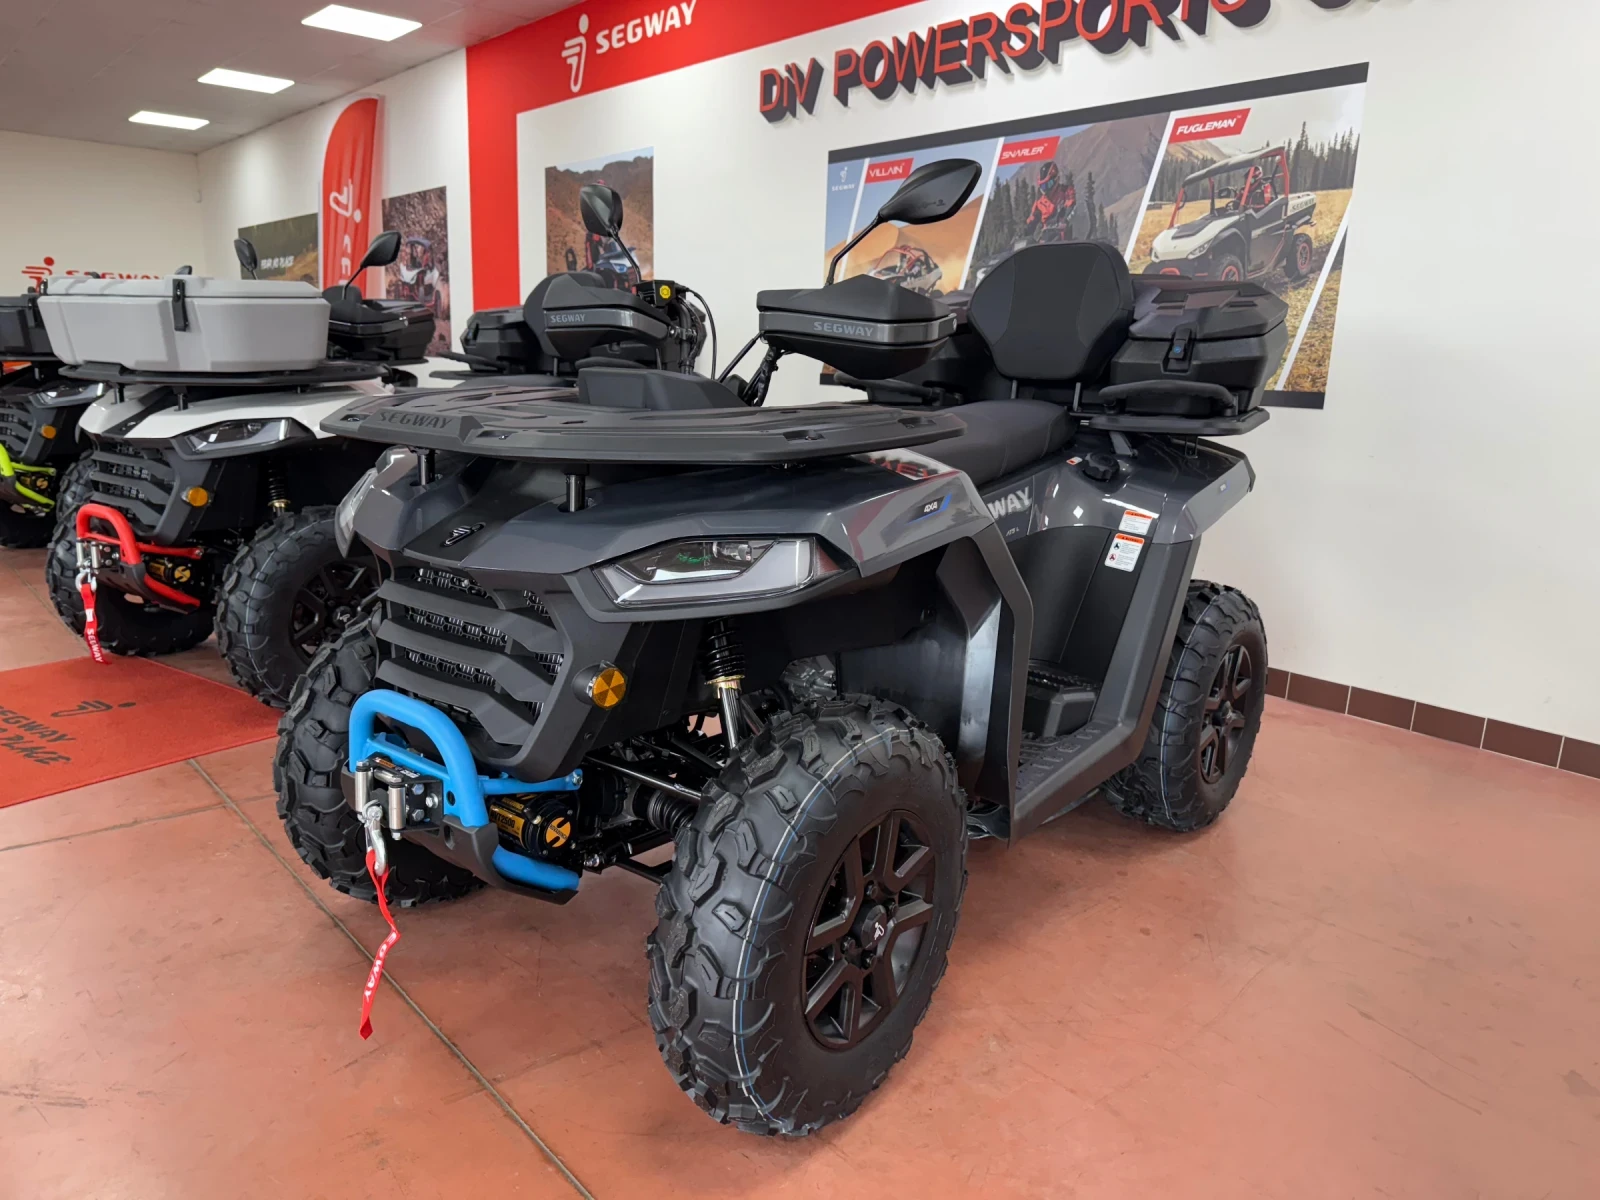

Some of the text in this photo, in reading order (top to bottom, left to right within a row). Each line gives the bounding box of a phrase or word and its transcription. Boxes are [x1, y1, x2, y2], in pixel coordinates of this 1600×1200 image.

[596, 0, 697, 55] SEGWAY
[833, 0, 1260, 108] POWERSPOR
[550, 313, 586, 323] SEGWAY
[813, 321, 874, 337] SEGWAY
[380, 410, 453, 429] SEGWAY
[0, 705, 77, 742] EGWAY
